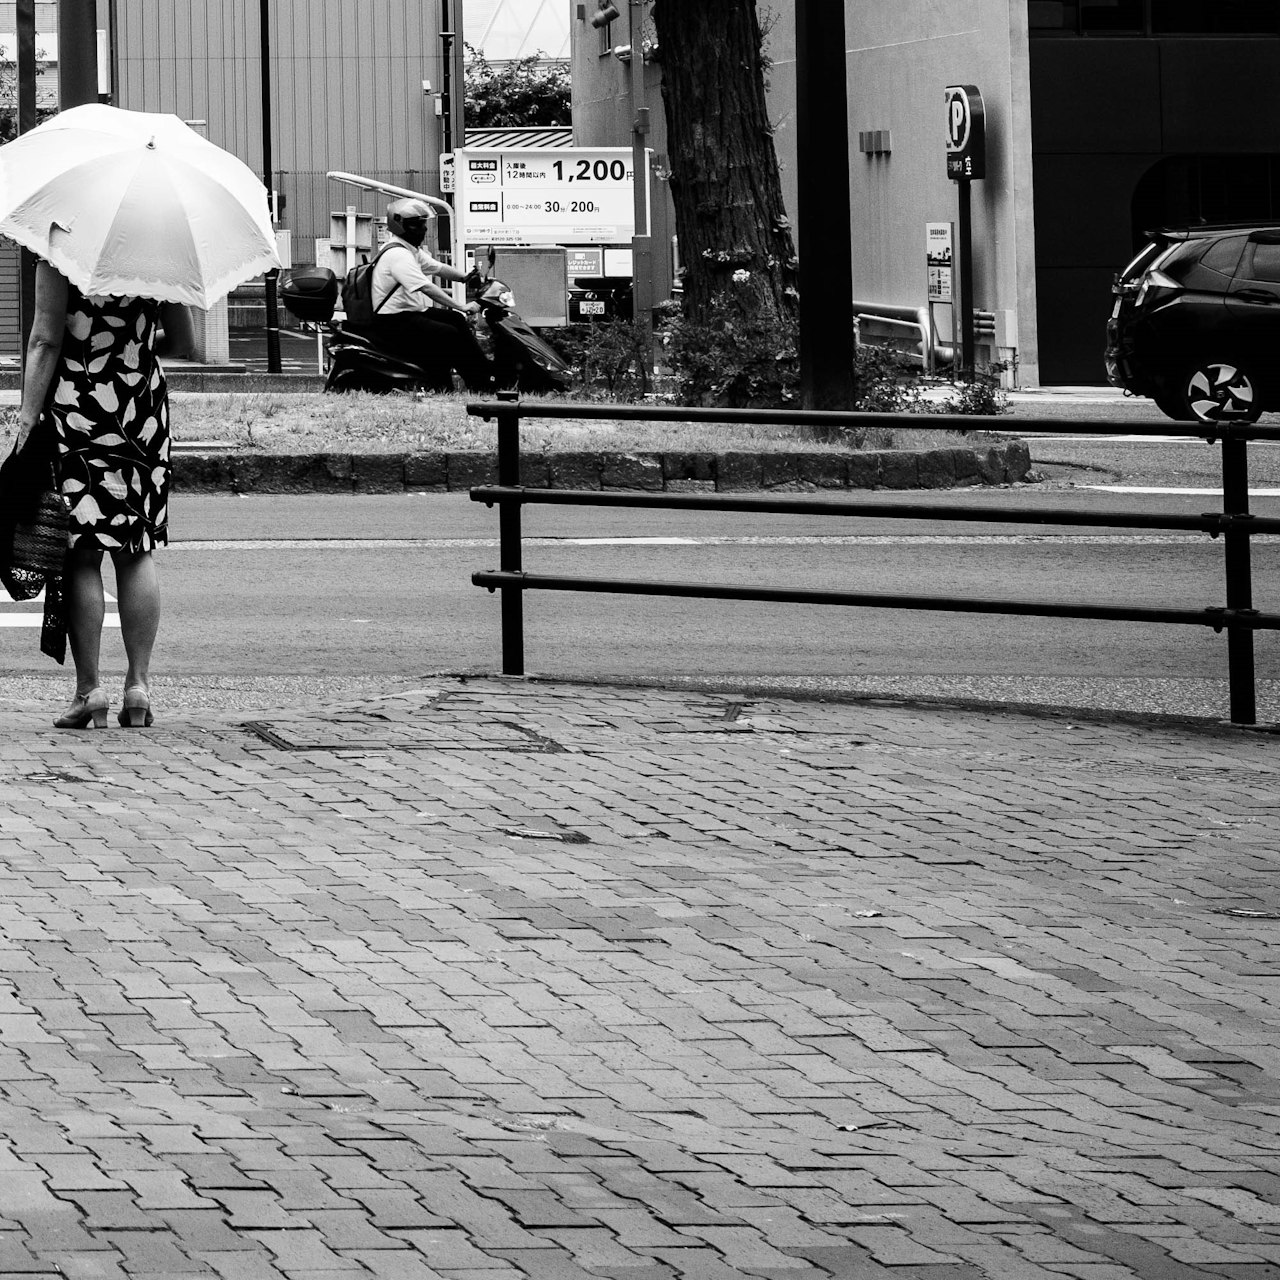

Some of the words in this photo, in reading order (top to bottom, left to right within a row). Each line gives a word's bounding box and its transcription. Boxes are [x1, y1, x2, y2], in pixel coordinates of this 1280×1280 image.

[951, 100, 964, 141] P
[506, 170, 546, 179] 12時間以内
